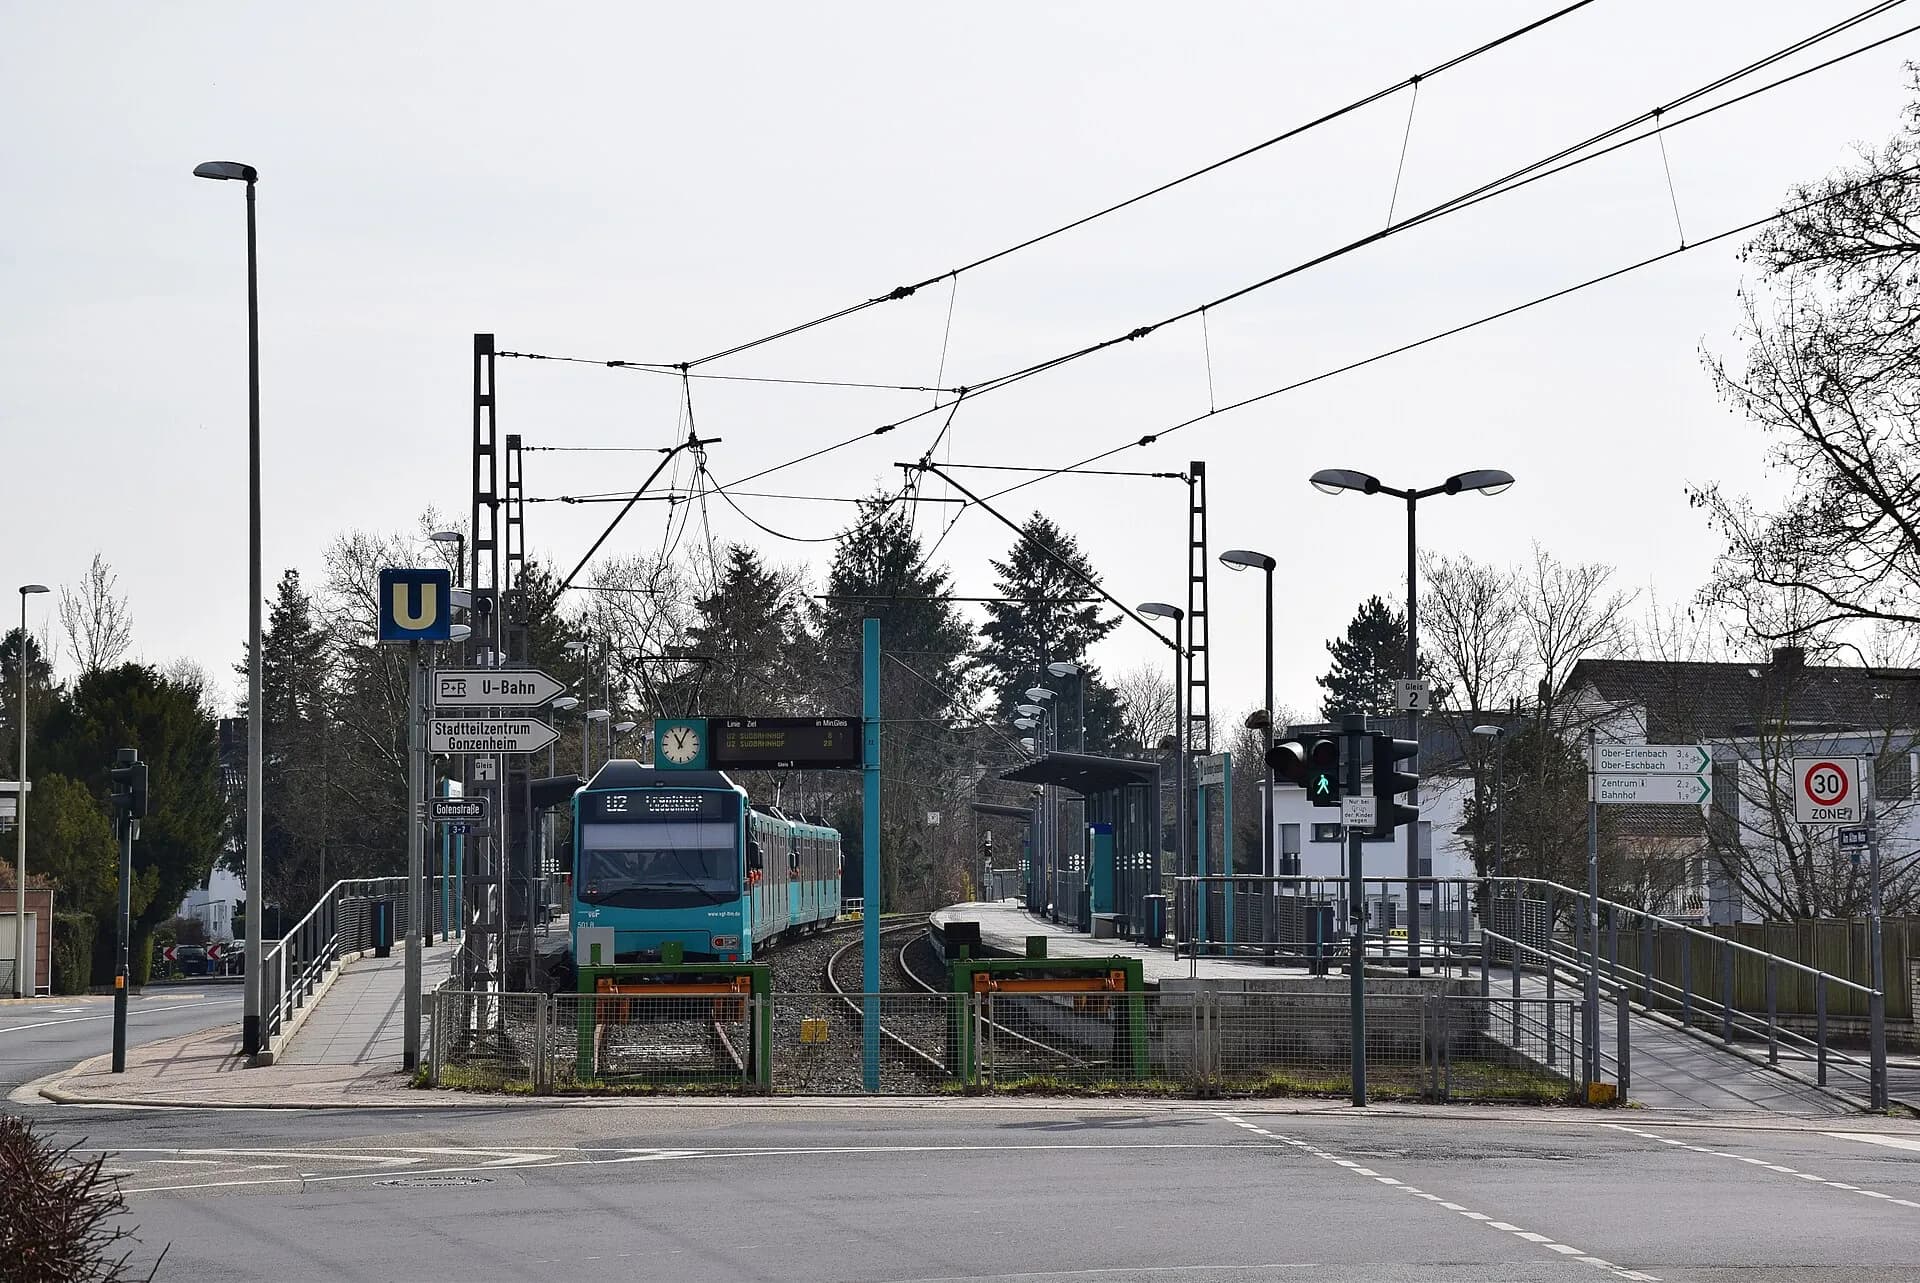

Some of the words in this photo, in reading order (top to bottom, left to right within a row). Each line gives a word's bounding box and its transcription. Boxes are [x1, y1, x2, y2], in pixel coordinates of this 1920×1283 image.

[392, 583, 437, 630] U
[482, 680, 536, 695] U-Bahn
[1405, 683, 1423, 691] Gleis
[1409, 692, 1419, 708] 2
[435, 721, 531, 736] Stadtteilzentrum
[449, 737, 517, 750] Gonzenheim
[1601, 748, 1668, 758] Ober-Erlenbach
[1601, 760, 1666, 770] Ober-Eschbach
[480, 770, 487, 780] 1
[1601, 779, 1638, 788] Zentrum
[1813, 774, 1839, 794] 30
[1601, 791, 1636, 800] Bahnhof
[436, 803, 480, 816] Gotenstraße
[606, 795, 628, 812] U2
[1811, 808, 1845, 820] ZONE
